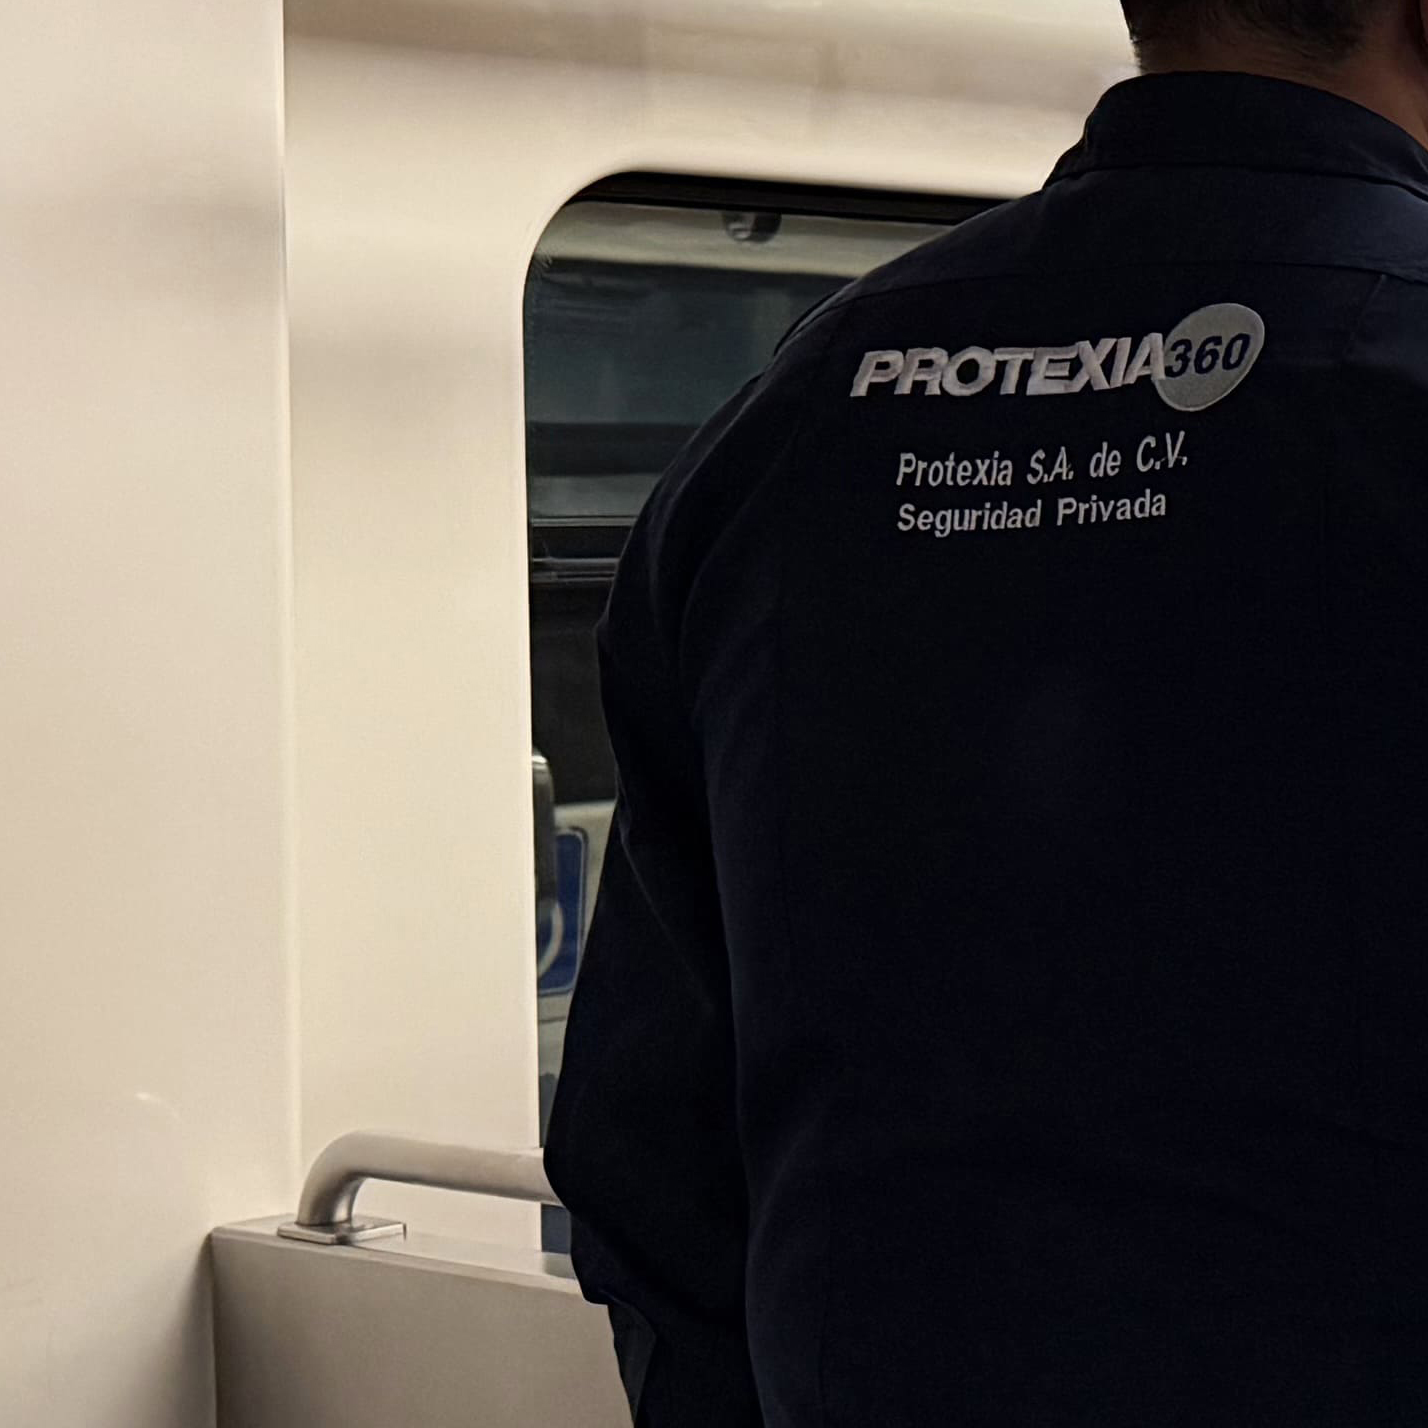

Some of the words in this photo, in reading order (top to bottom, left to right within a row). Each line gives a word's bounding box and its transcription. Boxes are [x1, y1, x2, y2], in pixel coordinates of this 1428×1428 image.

[897, 450, 1013, 487] Protexia
[1026, 446, 1074, 484] S.A.
[1089, 441, 1121, 479] de
[1136, 430, 1188, 472] C.V.
[896, 501, 1042, 538] Seguridad
[1056, 489, 1167, 527] Privada
